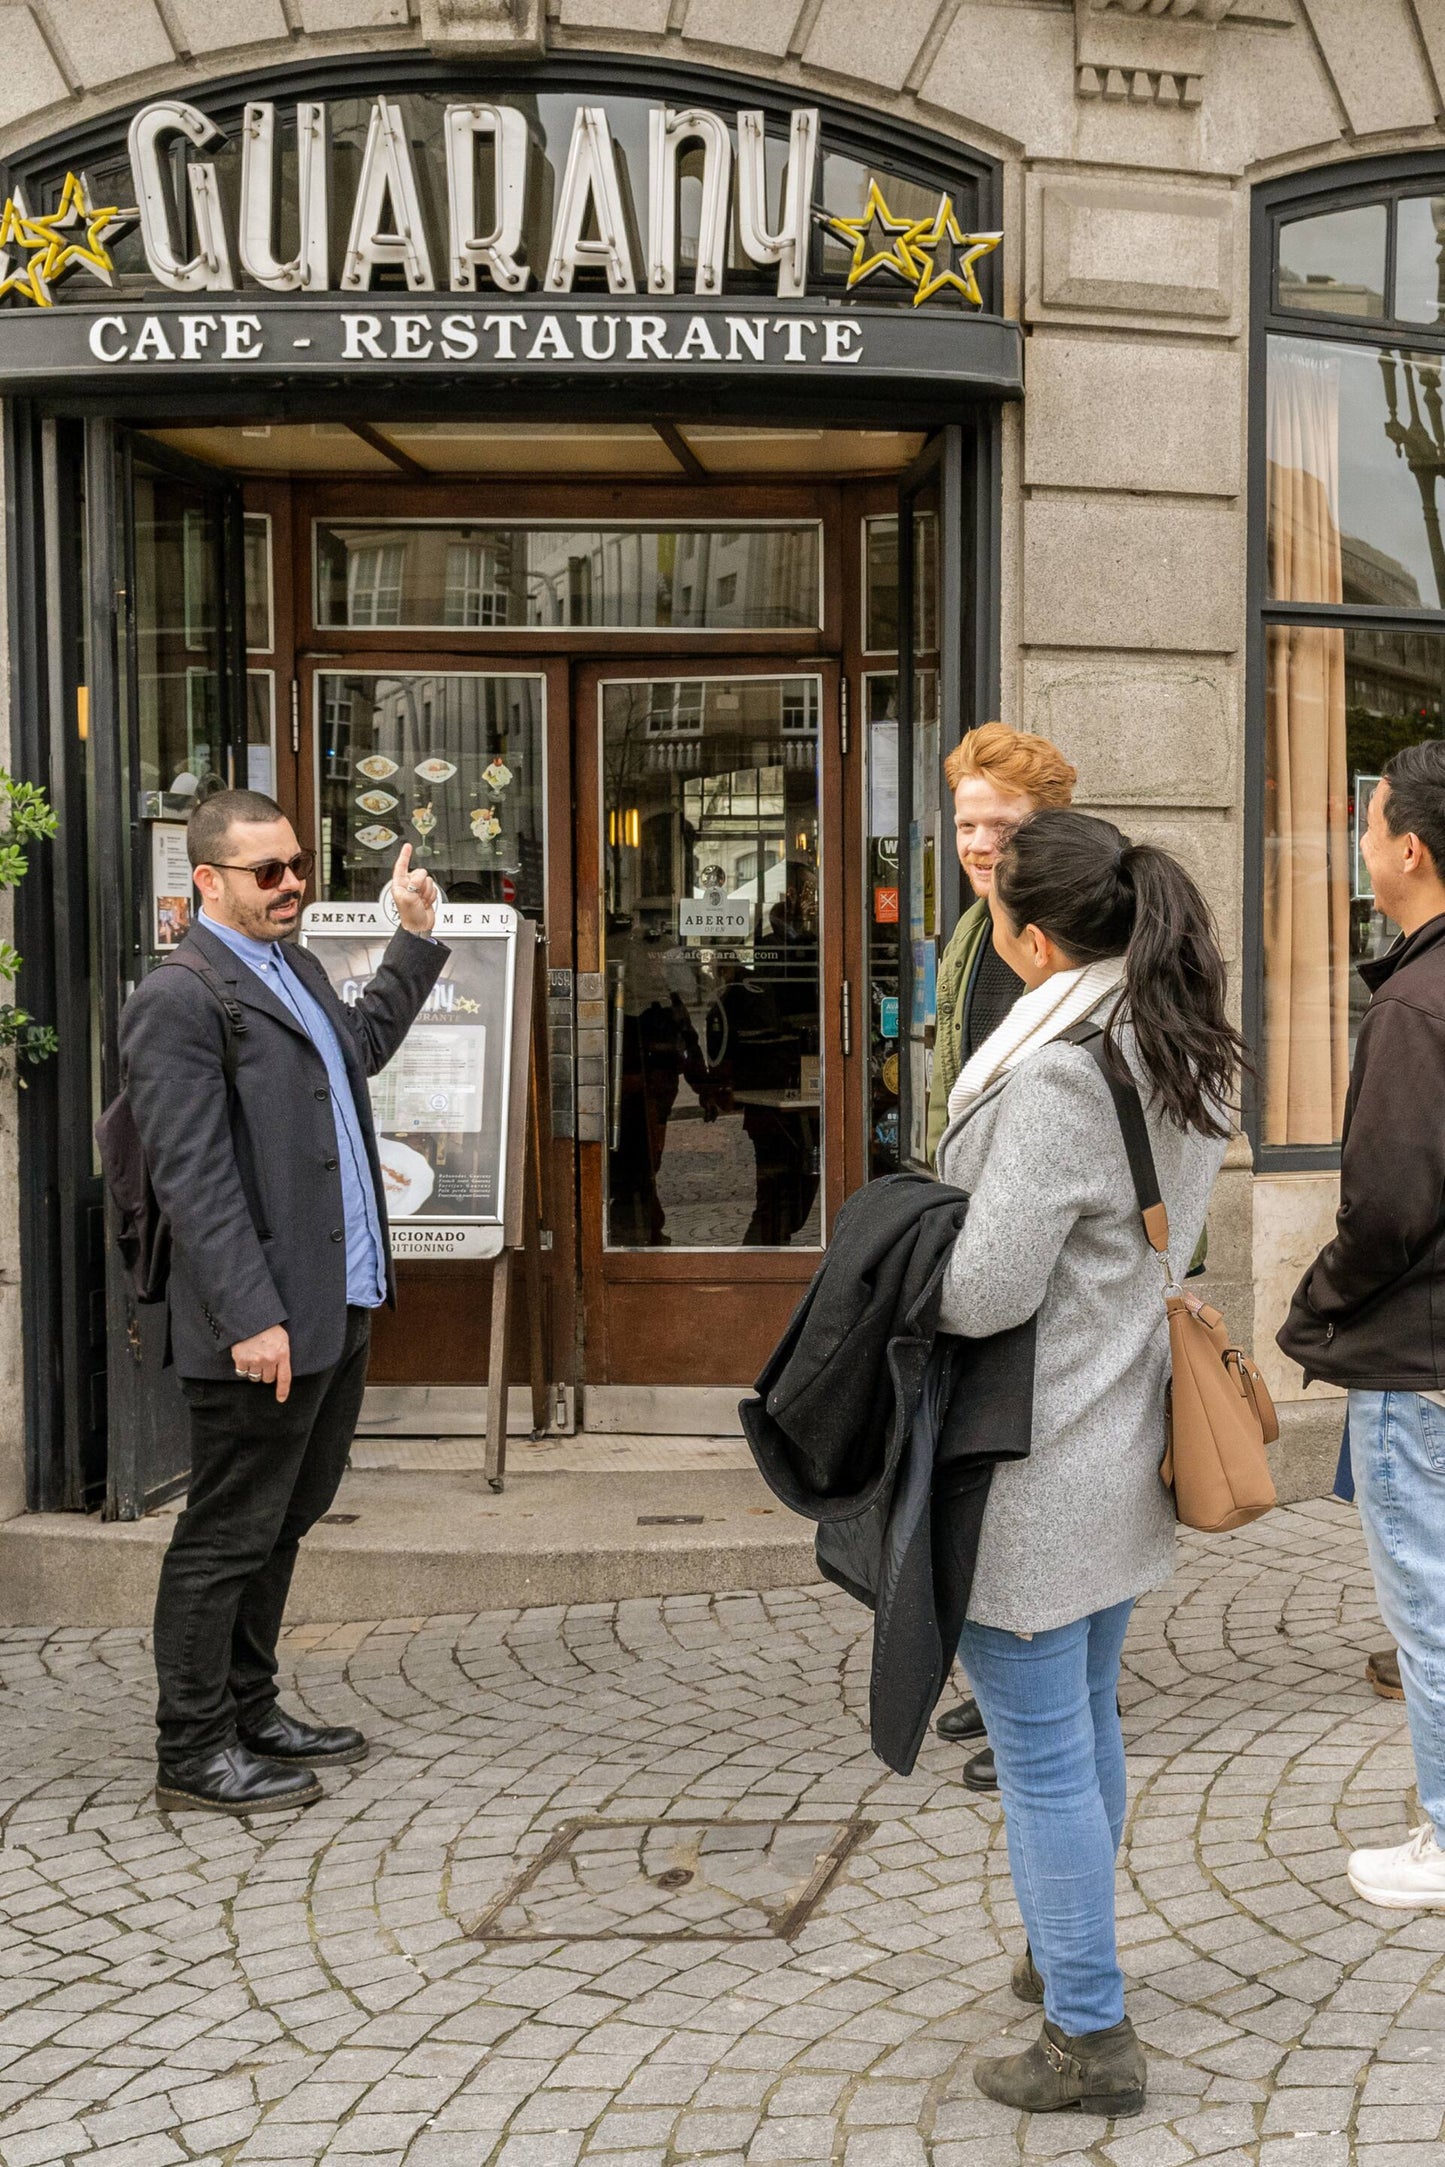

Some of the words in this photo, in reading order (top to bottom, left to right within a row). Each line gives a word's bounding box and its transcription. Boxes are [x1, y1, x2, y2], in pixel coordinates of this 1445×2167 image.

[88, 313, 264, 363] CAFE
[340, 313, 864, 364] RESTAURANTE
[311, 913, 377, 923] EMENTA
[685, 915, 745, 926] ABERTO
[392, 1232, 466, 1242] ICIONADO
